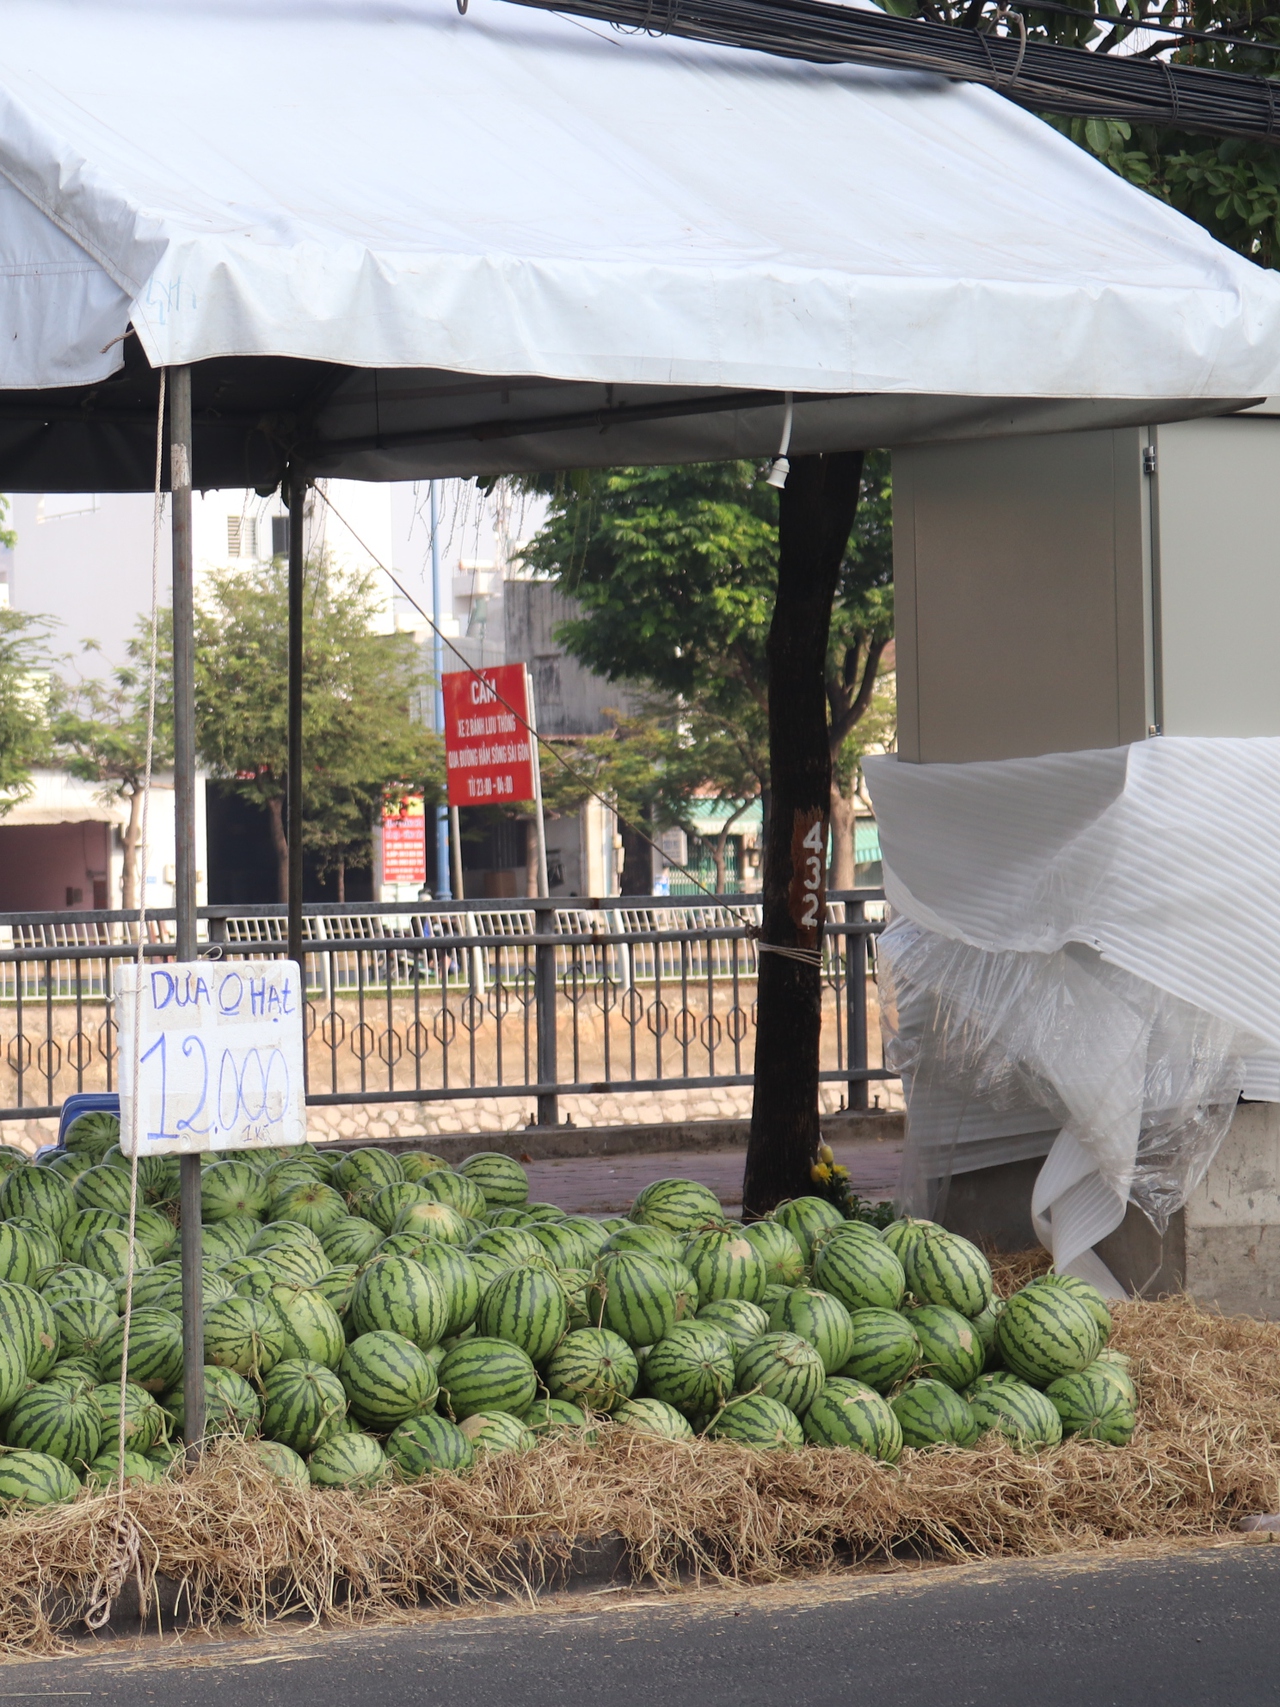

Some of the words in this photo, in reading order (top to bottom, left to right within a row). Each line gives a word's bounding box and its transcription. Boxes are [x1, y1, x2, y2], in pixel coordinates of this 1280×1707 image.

[471, 671, 497, 705] CẤM
[801, 821, 824, 928] 432
[151, 970, 210, 1010] DƯA
[140, 1032, 290, 1140] 12.000
